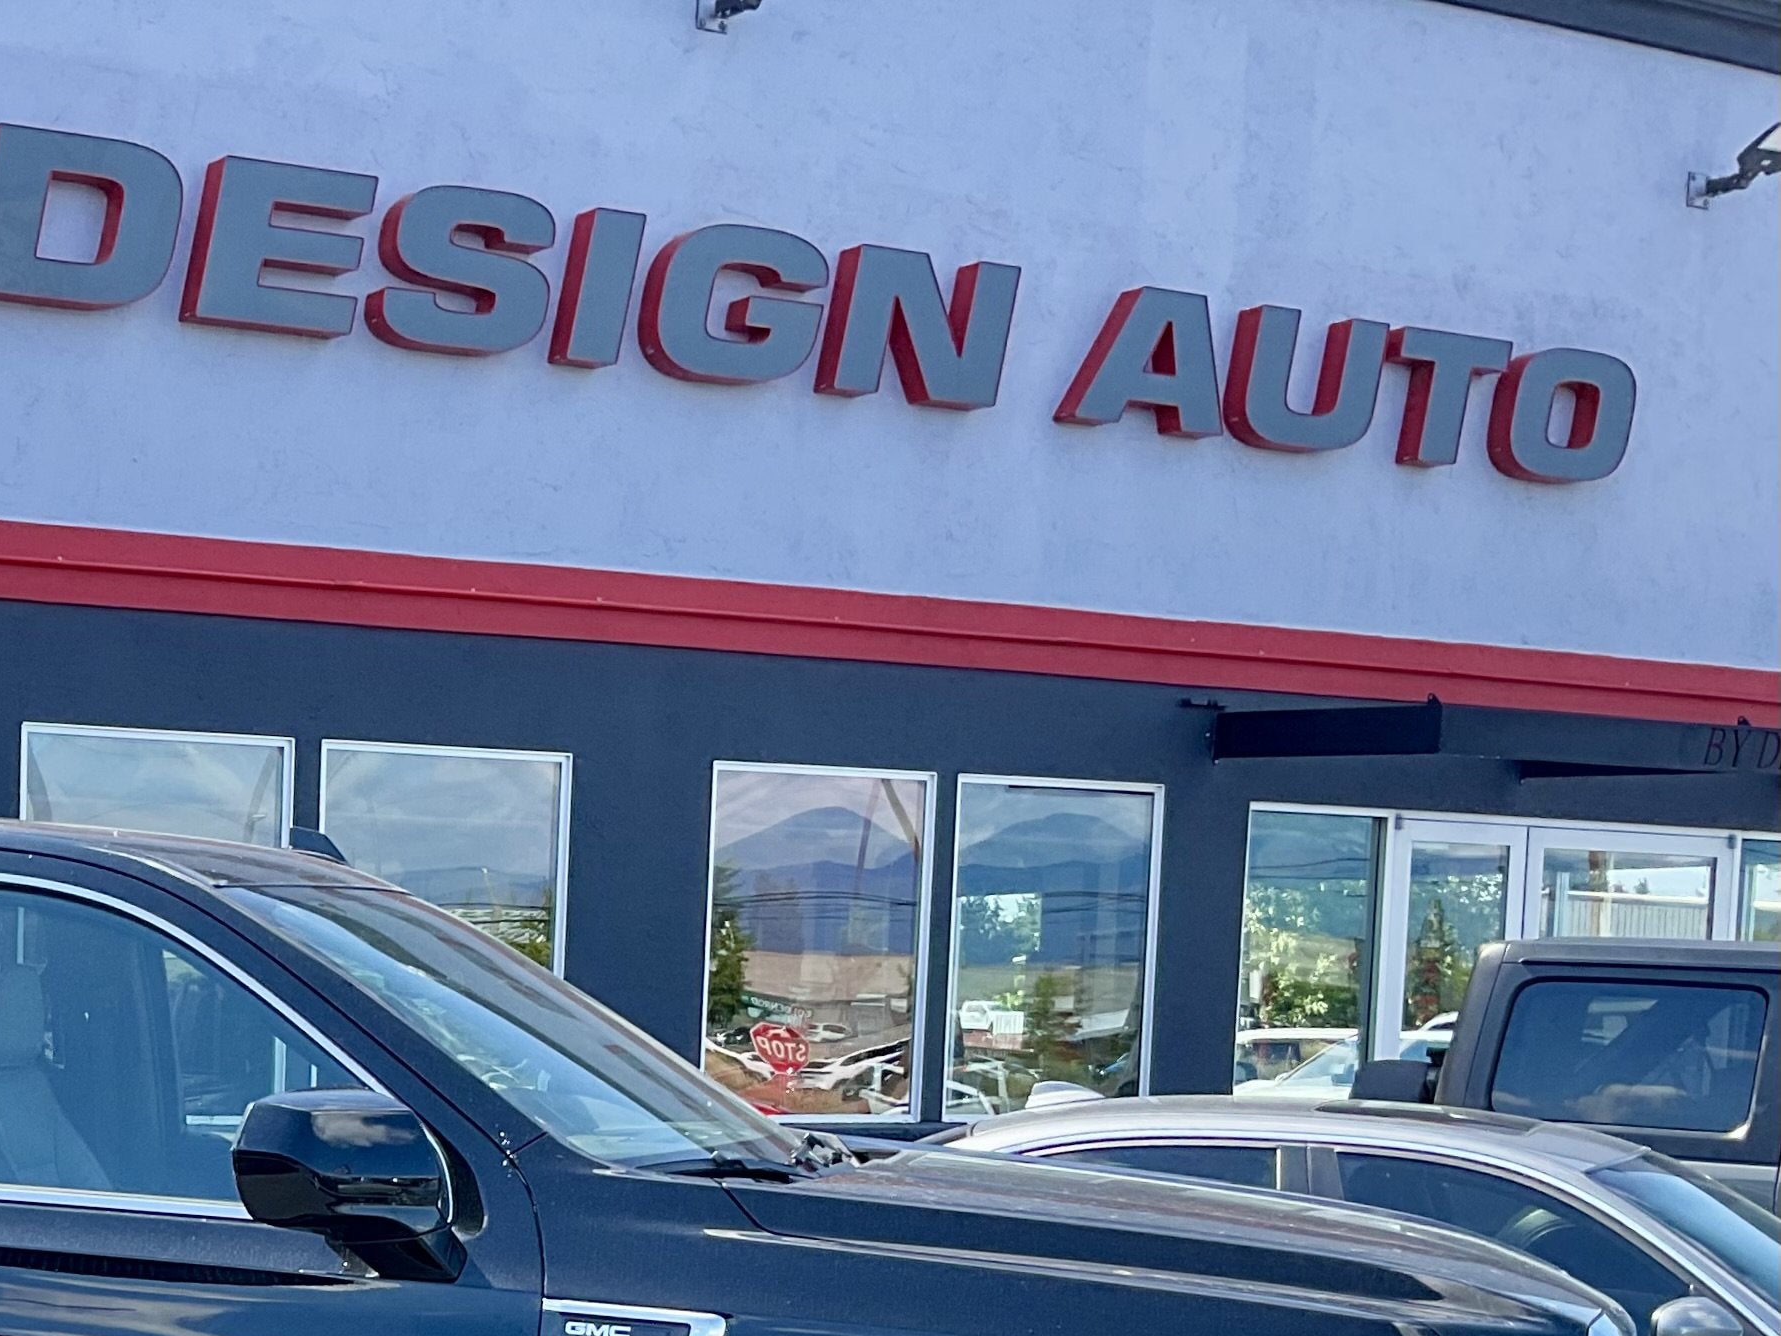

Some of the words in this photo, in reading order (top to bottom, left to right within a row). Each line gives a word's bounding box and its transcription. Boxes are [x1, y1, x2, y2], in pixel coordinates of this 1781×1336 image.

[1053, 286, 1636, 485] AUTO
[1703, 728, 1751, 768] BY
[1757, 731, 1781, 769] D
